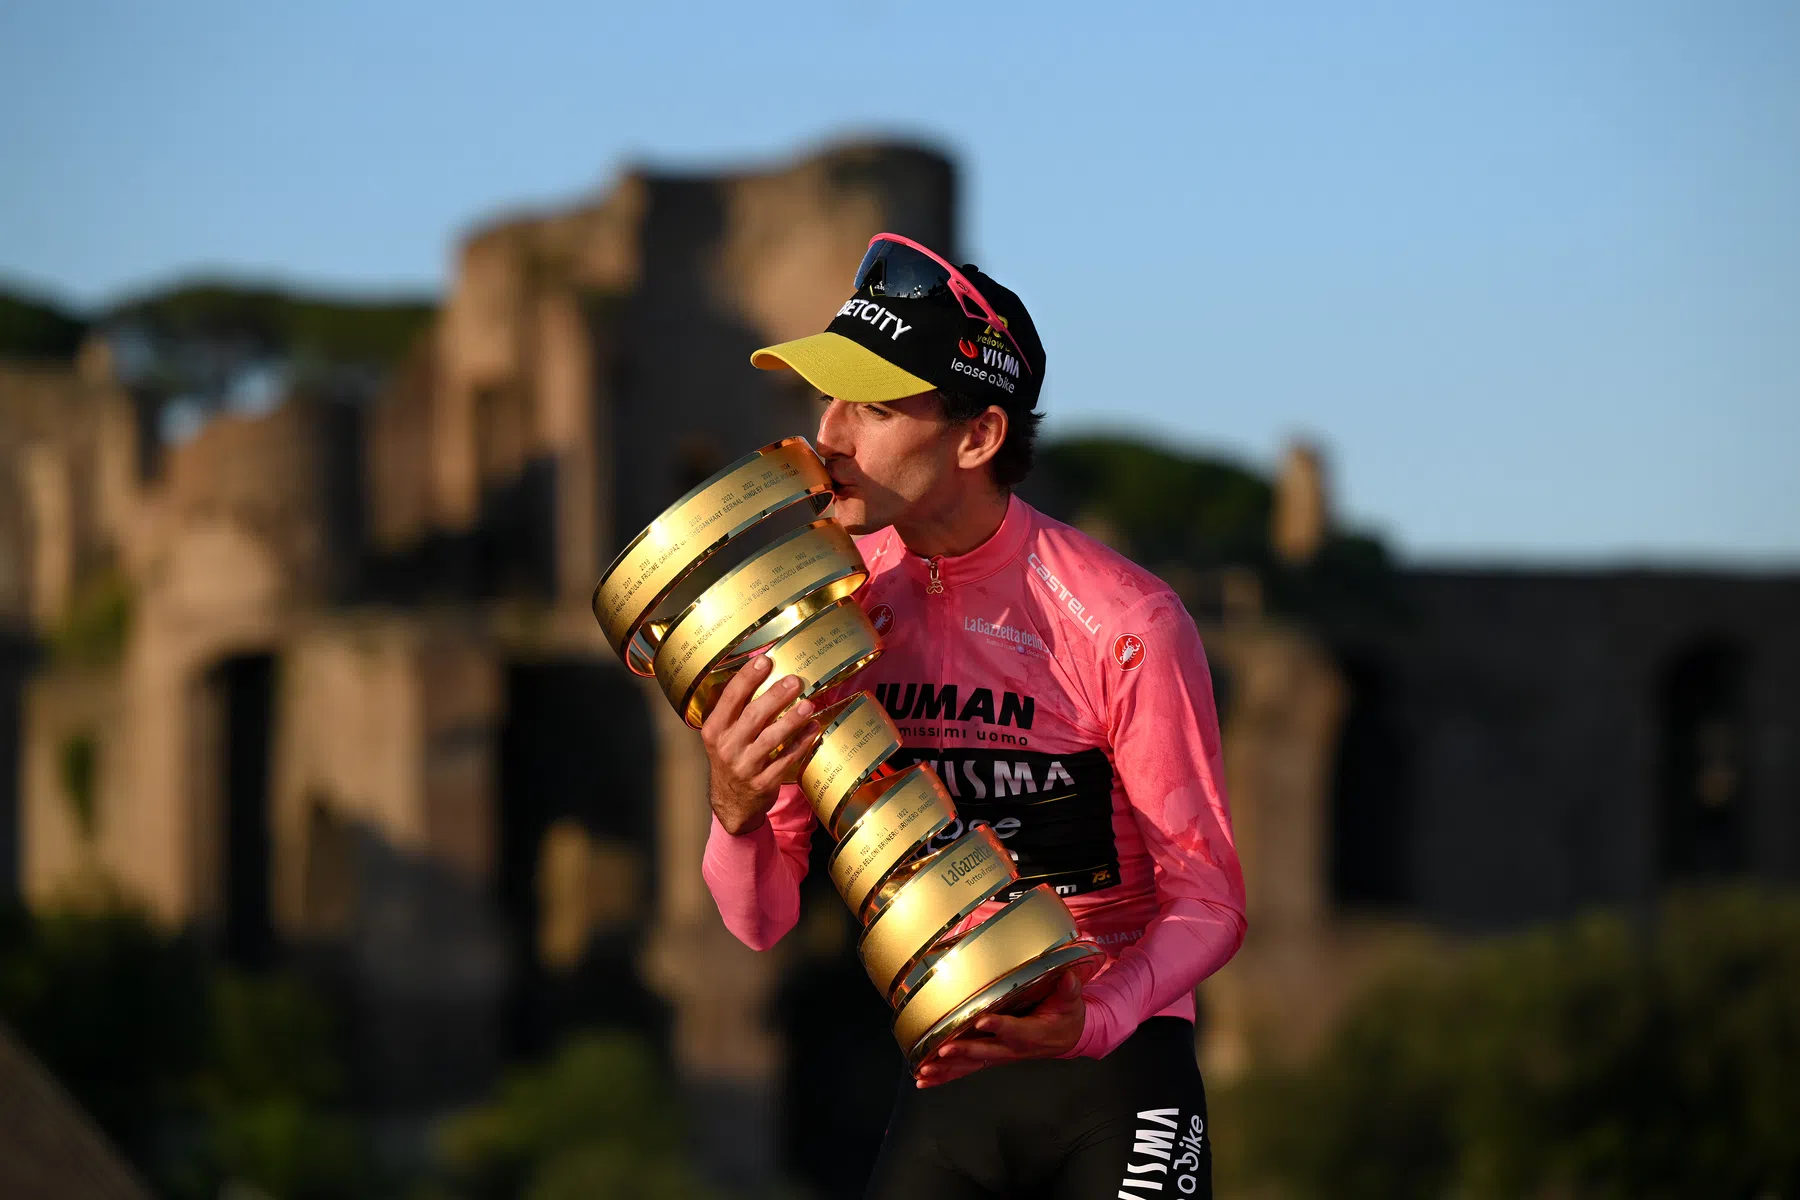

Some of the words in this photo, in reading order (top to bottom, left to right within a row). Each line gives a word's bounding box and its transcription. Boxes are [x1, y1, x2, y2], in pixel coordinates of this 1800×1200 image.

[836, 299, 912, 340] BETCITY
[950, 357, 988, 381] lease
[983, 346, 1020, 379] VISMA
[976, 730, 1029, 747] uomo
